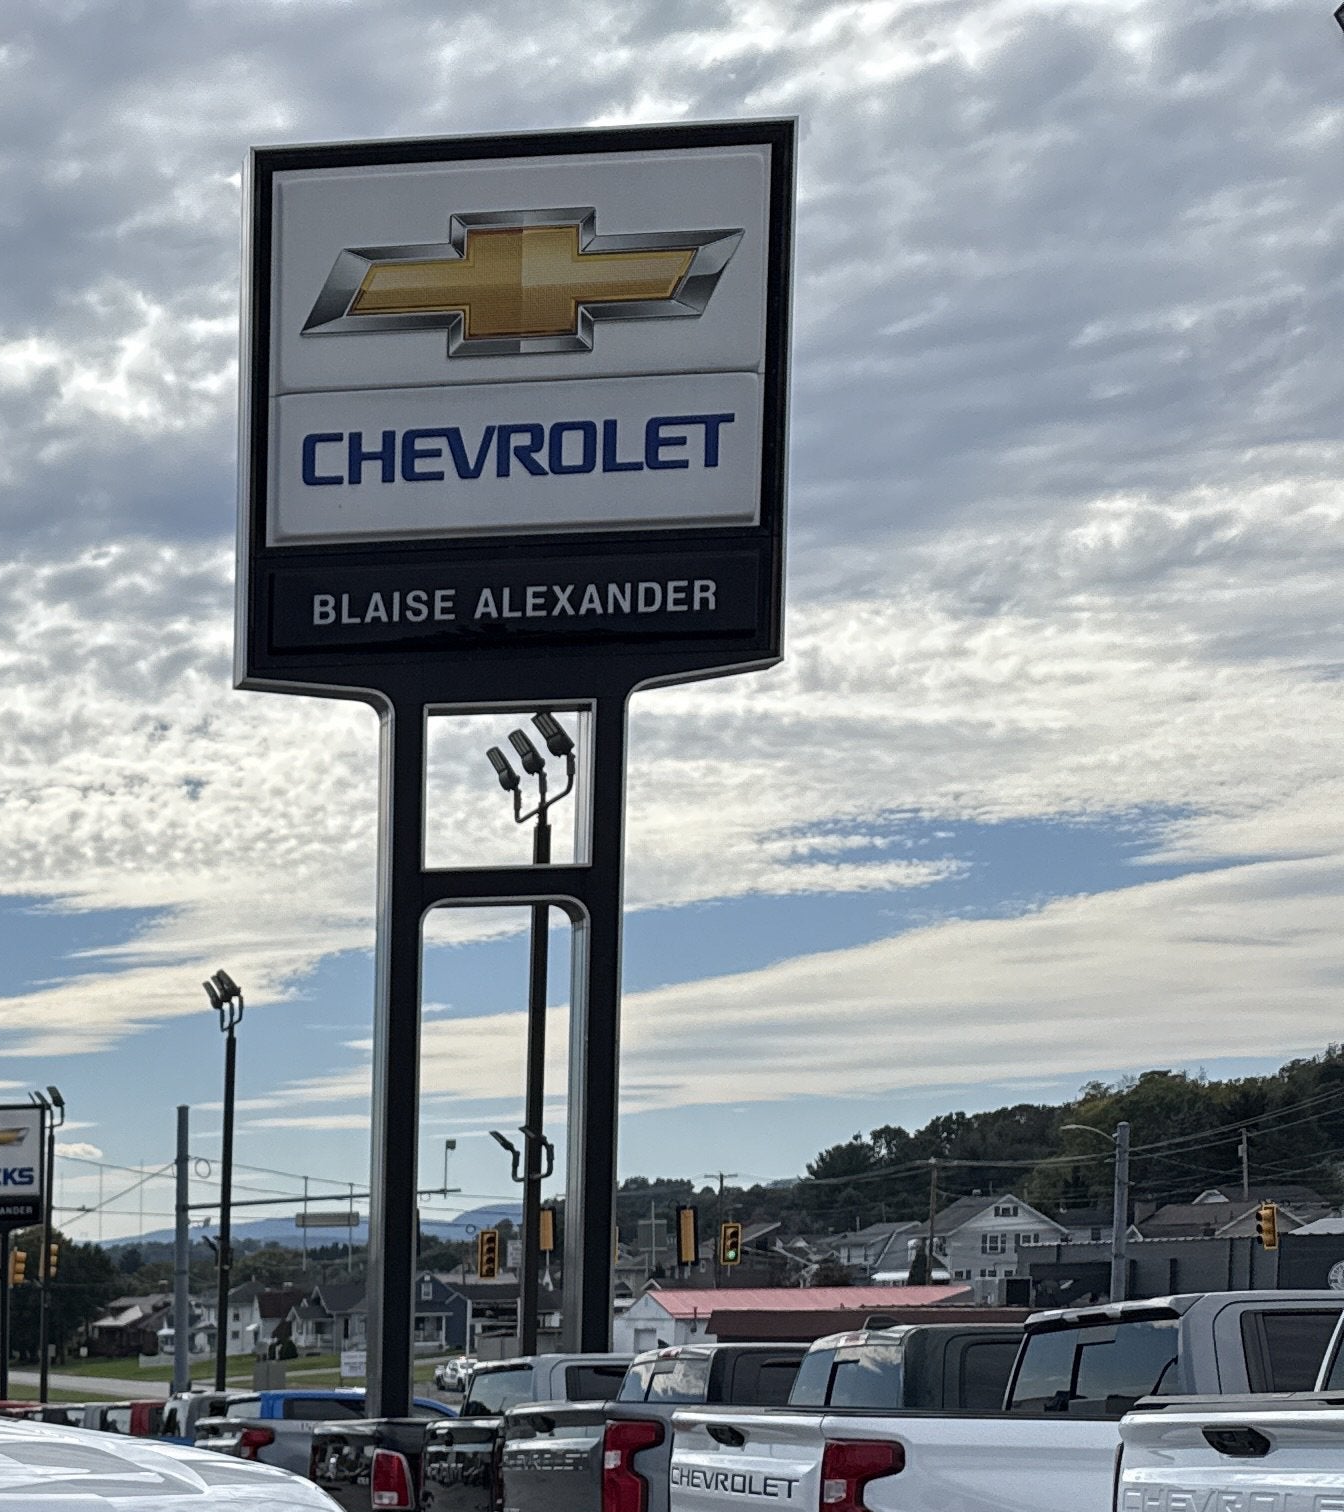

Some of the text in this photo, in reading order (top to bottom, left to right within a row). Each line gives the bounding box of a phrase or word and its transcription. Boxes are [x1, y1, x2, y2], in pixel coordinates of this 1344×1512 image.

[301, 411, 736, 487] CHEVROLET
[312, 578, 718, 626] BLAISE ALEXANDER
[671, 1466, 800, 1499] CHEVROLET
